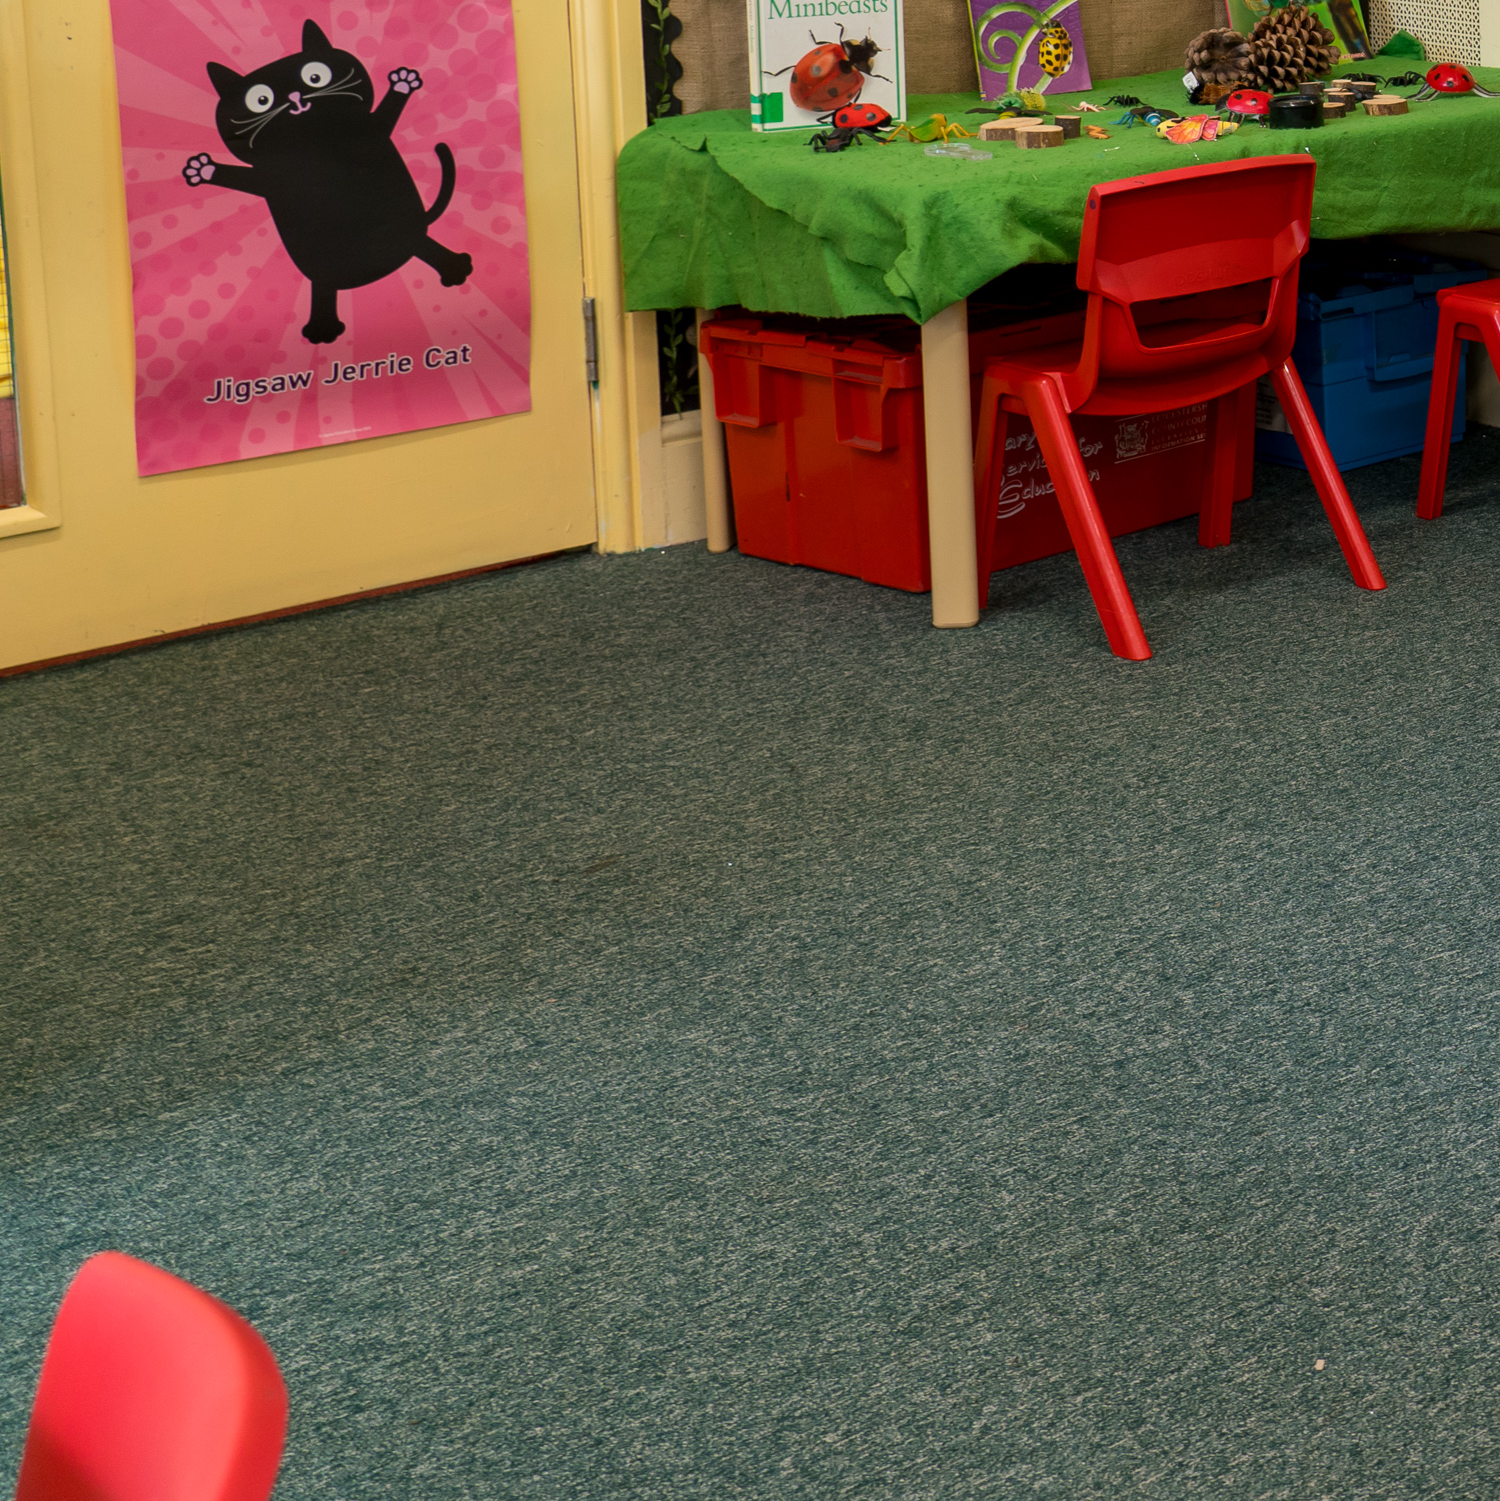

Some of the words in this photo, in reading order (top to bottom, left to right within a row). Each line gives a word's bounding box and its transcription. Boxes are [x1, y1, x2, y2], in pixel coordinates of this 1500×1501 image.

[205, 371, 313, 404] Jigsaw
[323, 353, 413, 384] Jerrie
[424, 345, 472, 368] Cat
